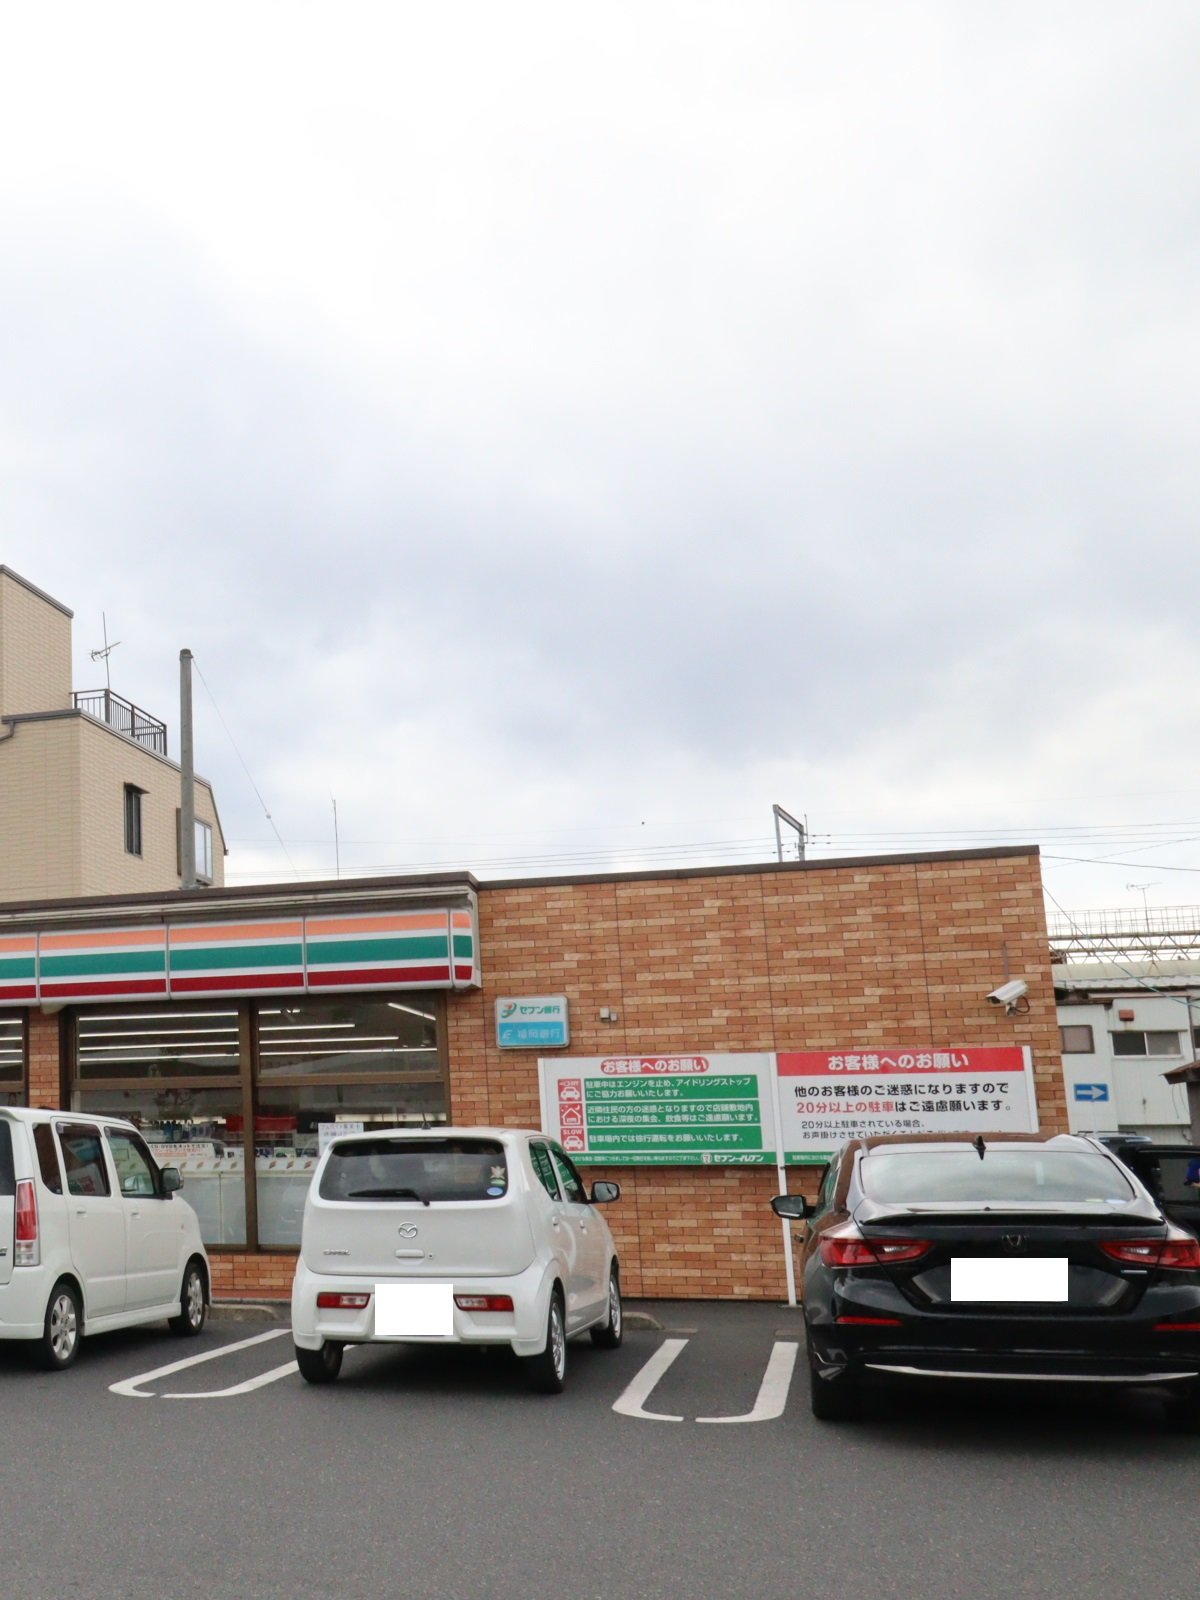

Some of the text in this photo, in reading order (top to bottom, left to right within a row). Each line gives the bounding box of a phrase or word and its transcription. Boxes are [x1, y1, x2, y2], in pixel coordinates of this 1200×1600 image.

[603, 1059, 707, 1073] お客様へのお願い
[828, 1052, 969, 1071] お客様へのお願い
[794, 1082, 1009, 1098] 他のお客様のご迷惑になりますので
[796, 1099, 1011, 1114] 20分以上の駐車はご遠慮願います。
